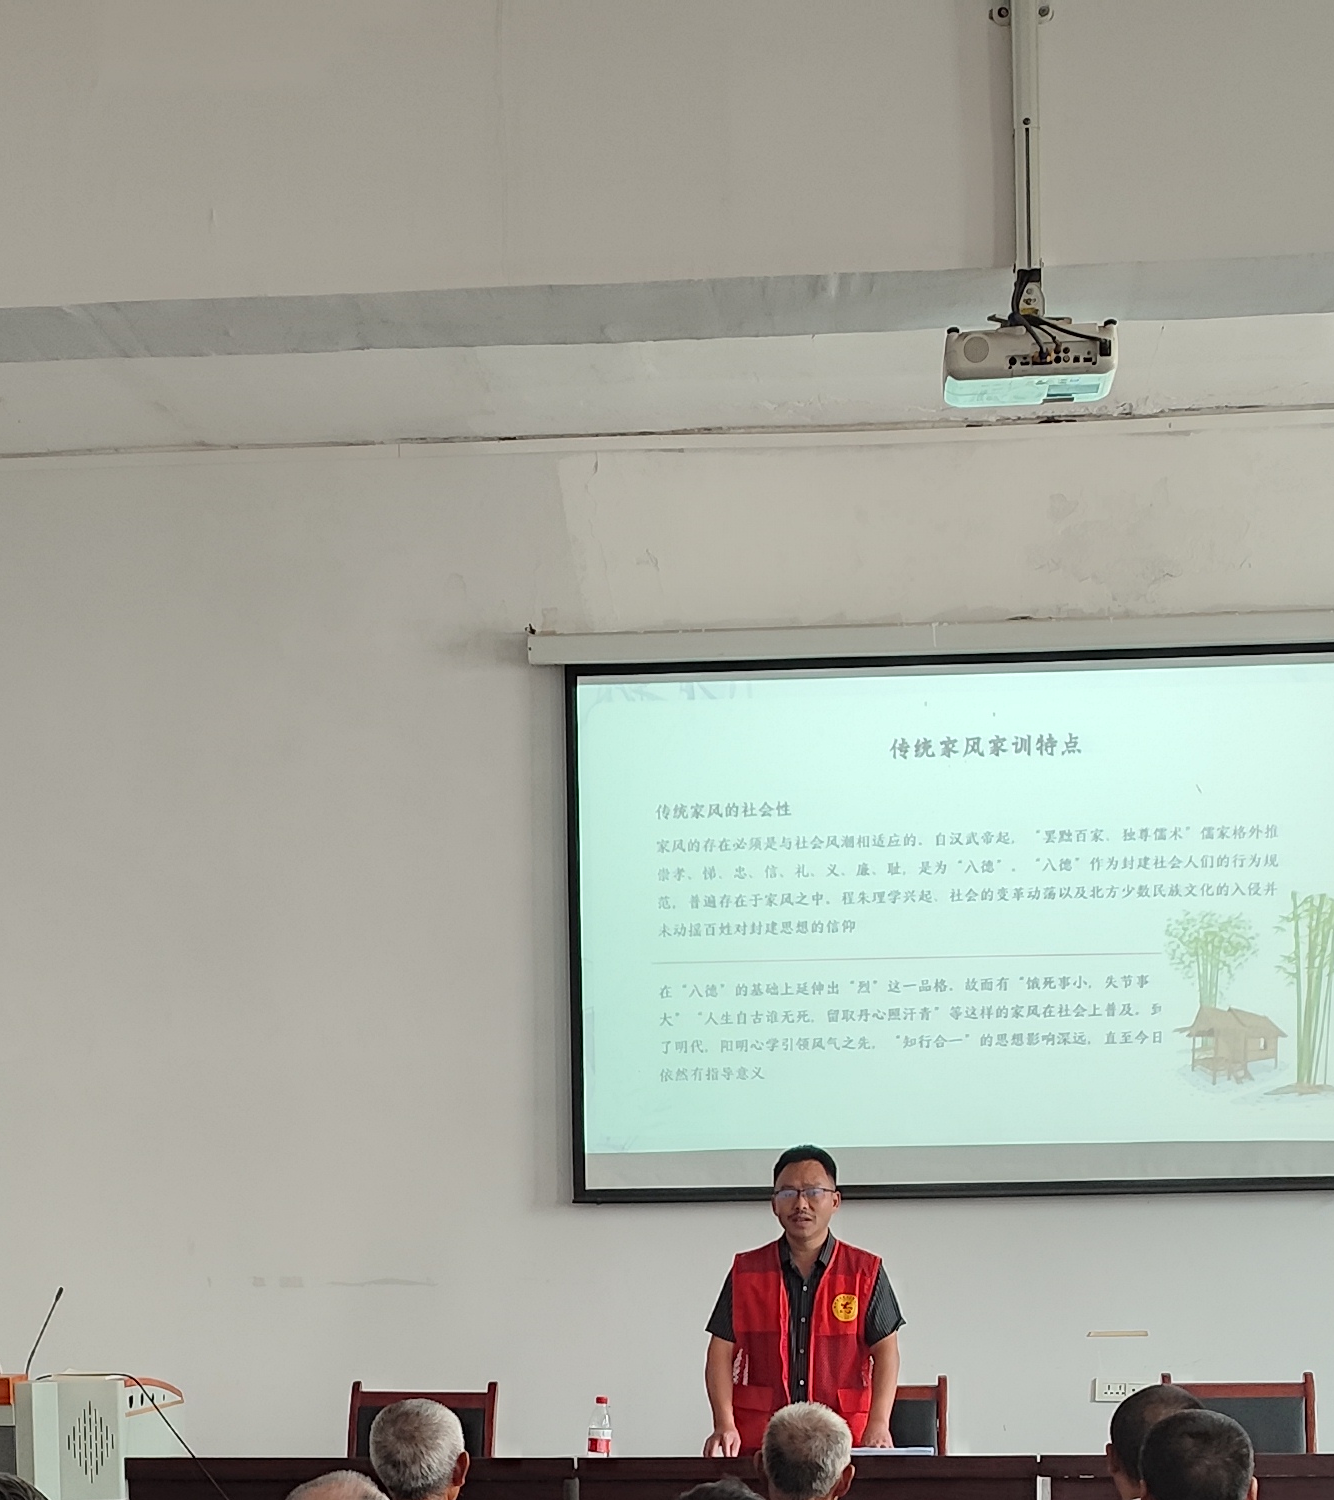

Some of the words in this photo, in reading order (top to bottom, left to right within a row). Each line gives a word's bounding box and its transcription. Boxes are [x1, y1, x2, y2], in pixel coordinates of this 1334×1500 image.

[889, 732, 1082, 760] 传统家风家训特点
[655, 801, 793, 820] 传统家风的社会性
[658, 919, 857, 938] 未动摇百姓对封建思想的信仰
[659, 1066, 765, 1083] 依然有指导意义
